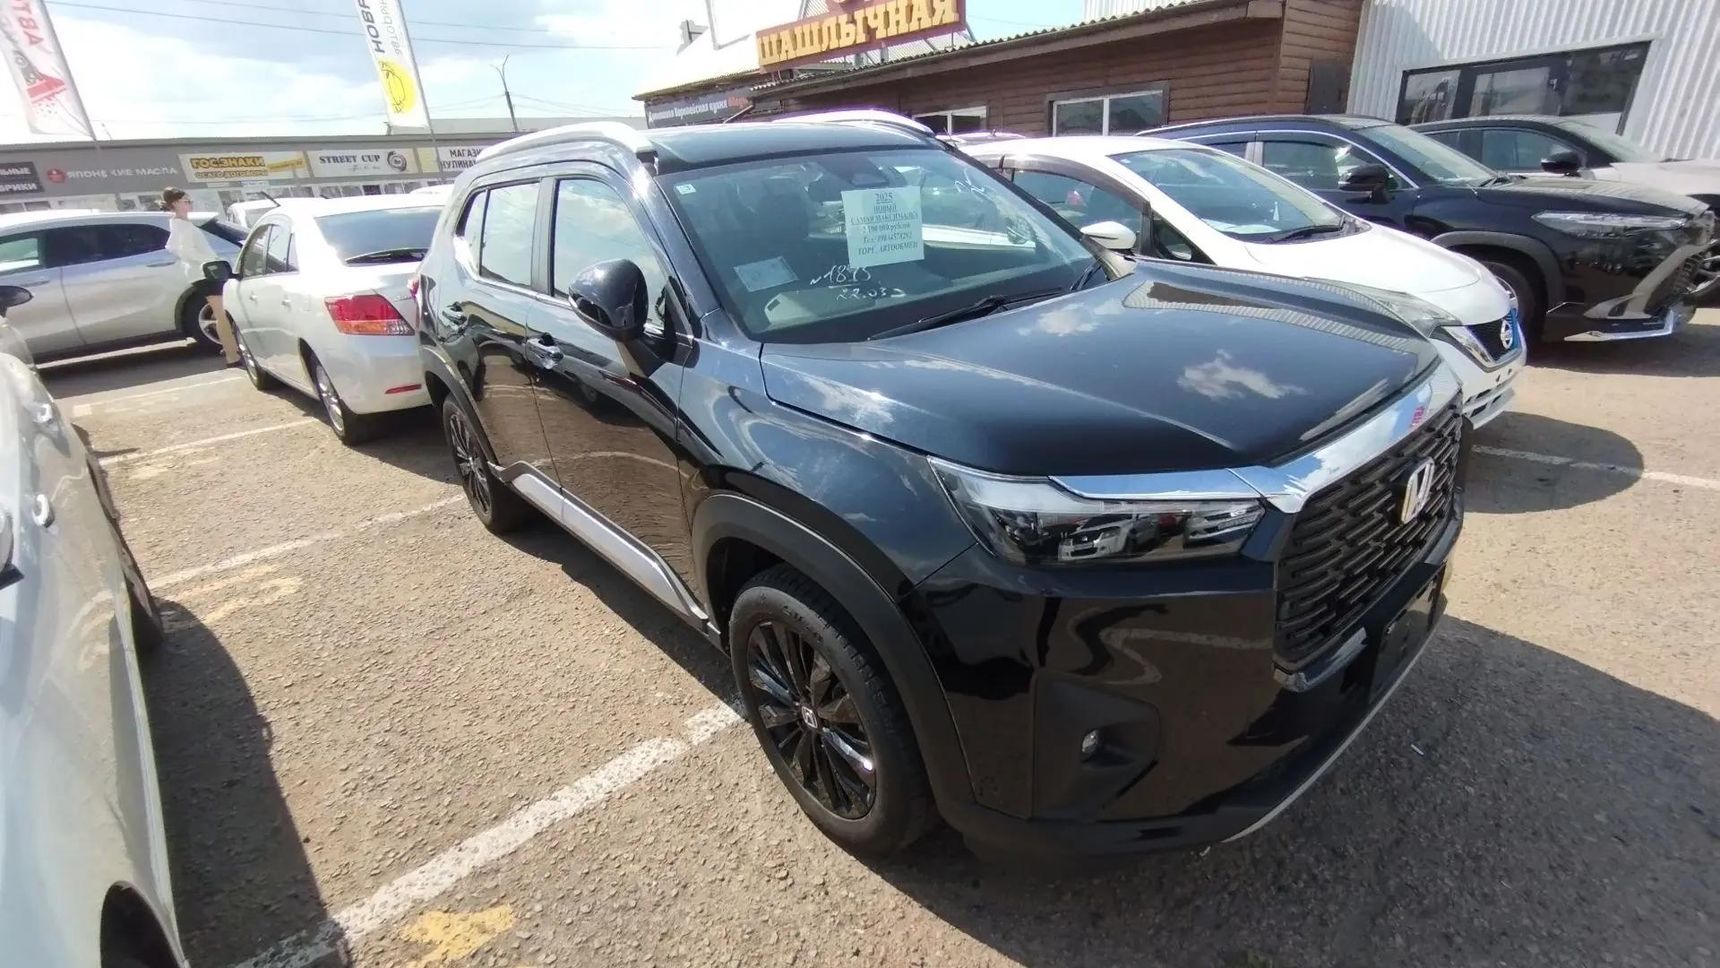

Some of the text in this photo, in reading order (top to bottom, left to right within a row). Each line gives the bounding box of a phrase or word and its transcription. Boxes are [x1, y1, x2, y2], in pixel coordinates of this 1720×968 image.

[12, 0, 44, 45] ТВА
[756, 0, 959, 66] ШАШЛЫЧНАЯ
[319, 154, 381, 164] STREET CUP
[136, 167, 178, 177] МАСЛА
[875, 192, 893, 200] 2025
